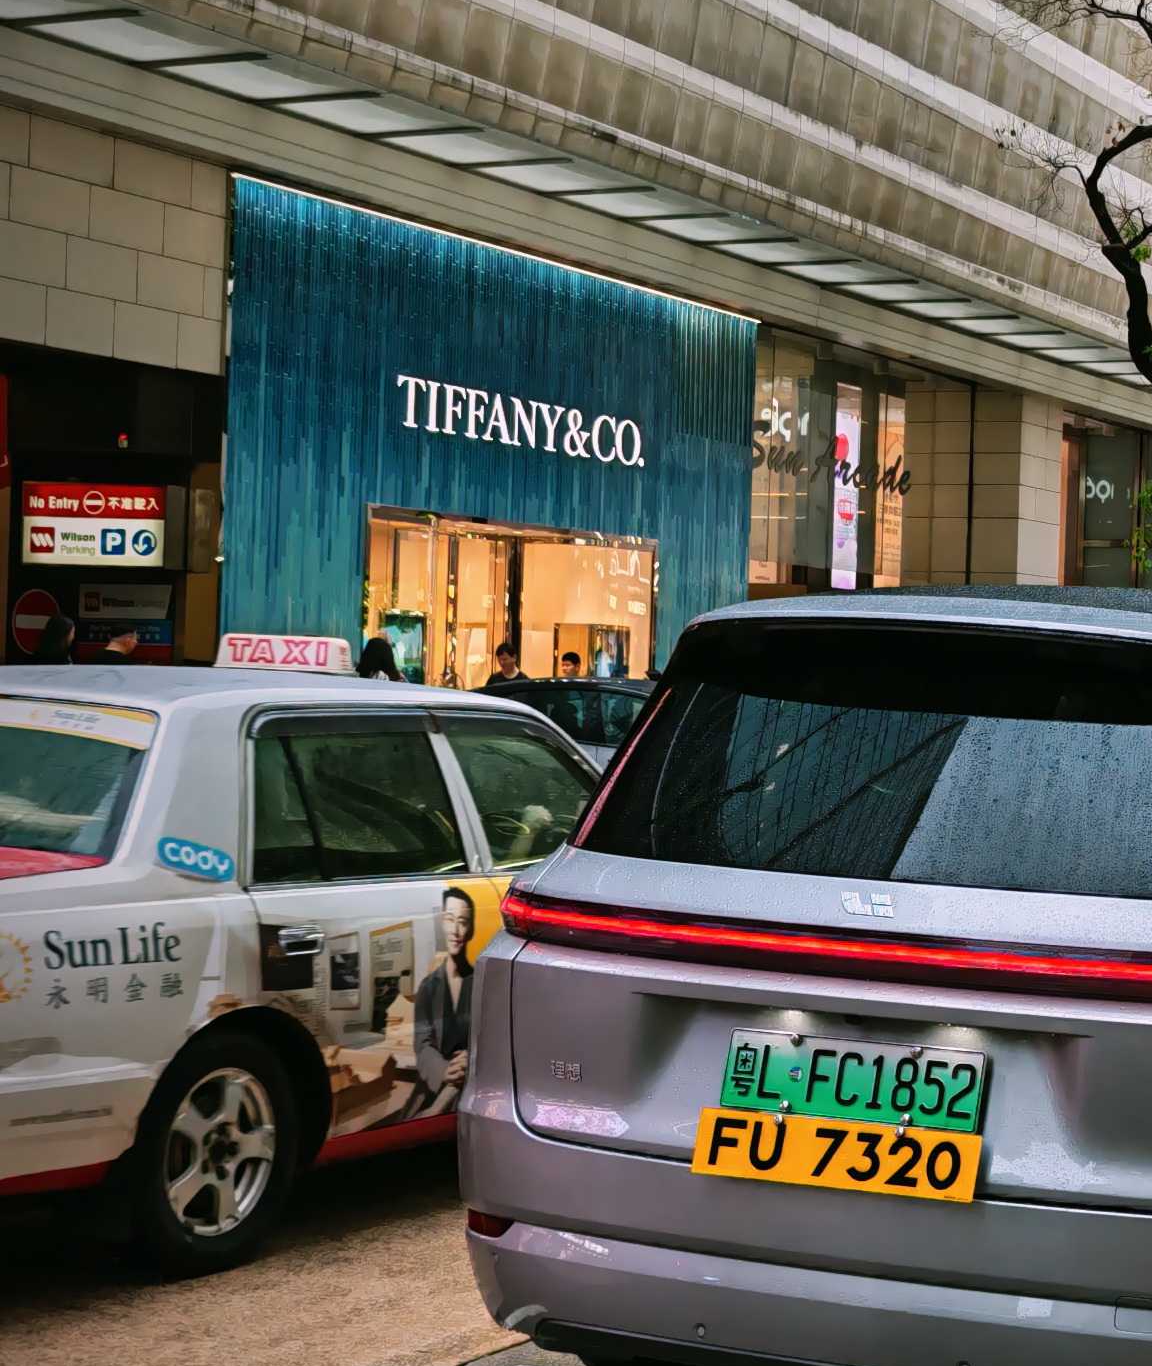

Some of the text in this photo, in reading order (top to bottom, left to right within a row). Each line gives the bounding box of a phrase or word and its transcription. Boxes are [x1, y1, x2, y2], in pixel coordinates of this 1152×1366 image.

[396, 374, 645, 468] TIFFANY&CO.
[751, 419, 805, 477] Sun
[810, 433, 912, 496] Arcade
[29, 495, 80, 513] No Entry
[60, 531, 96, 543] Wilson
[60, 545, 96, 556] Parking
[228, 637, 330, 667] TAXI
[43, 921, 183, 970] Sun Life
[44, 972, 184, 1010] 永明金融
[550, 1059, 582, 1082] 理想
[804, 1048, 977, 1120] FC1852
[707, 1116, 962, 1191] FU 7320
